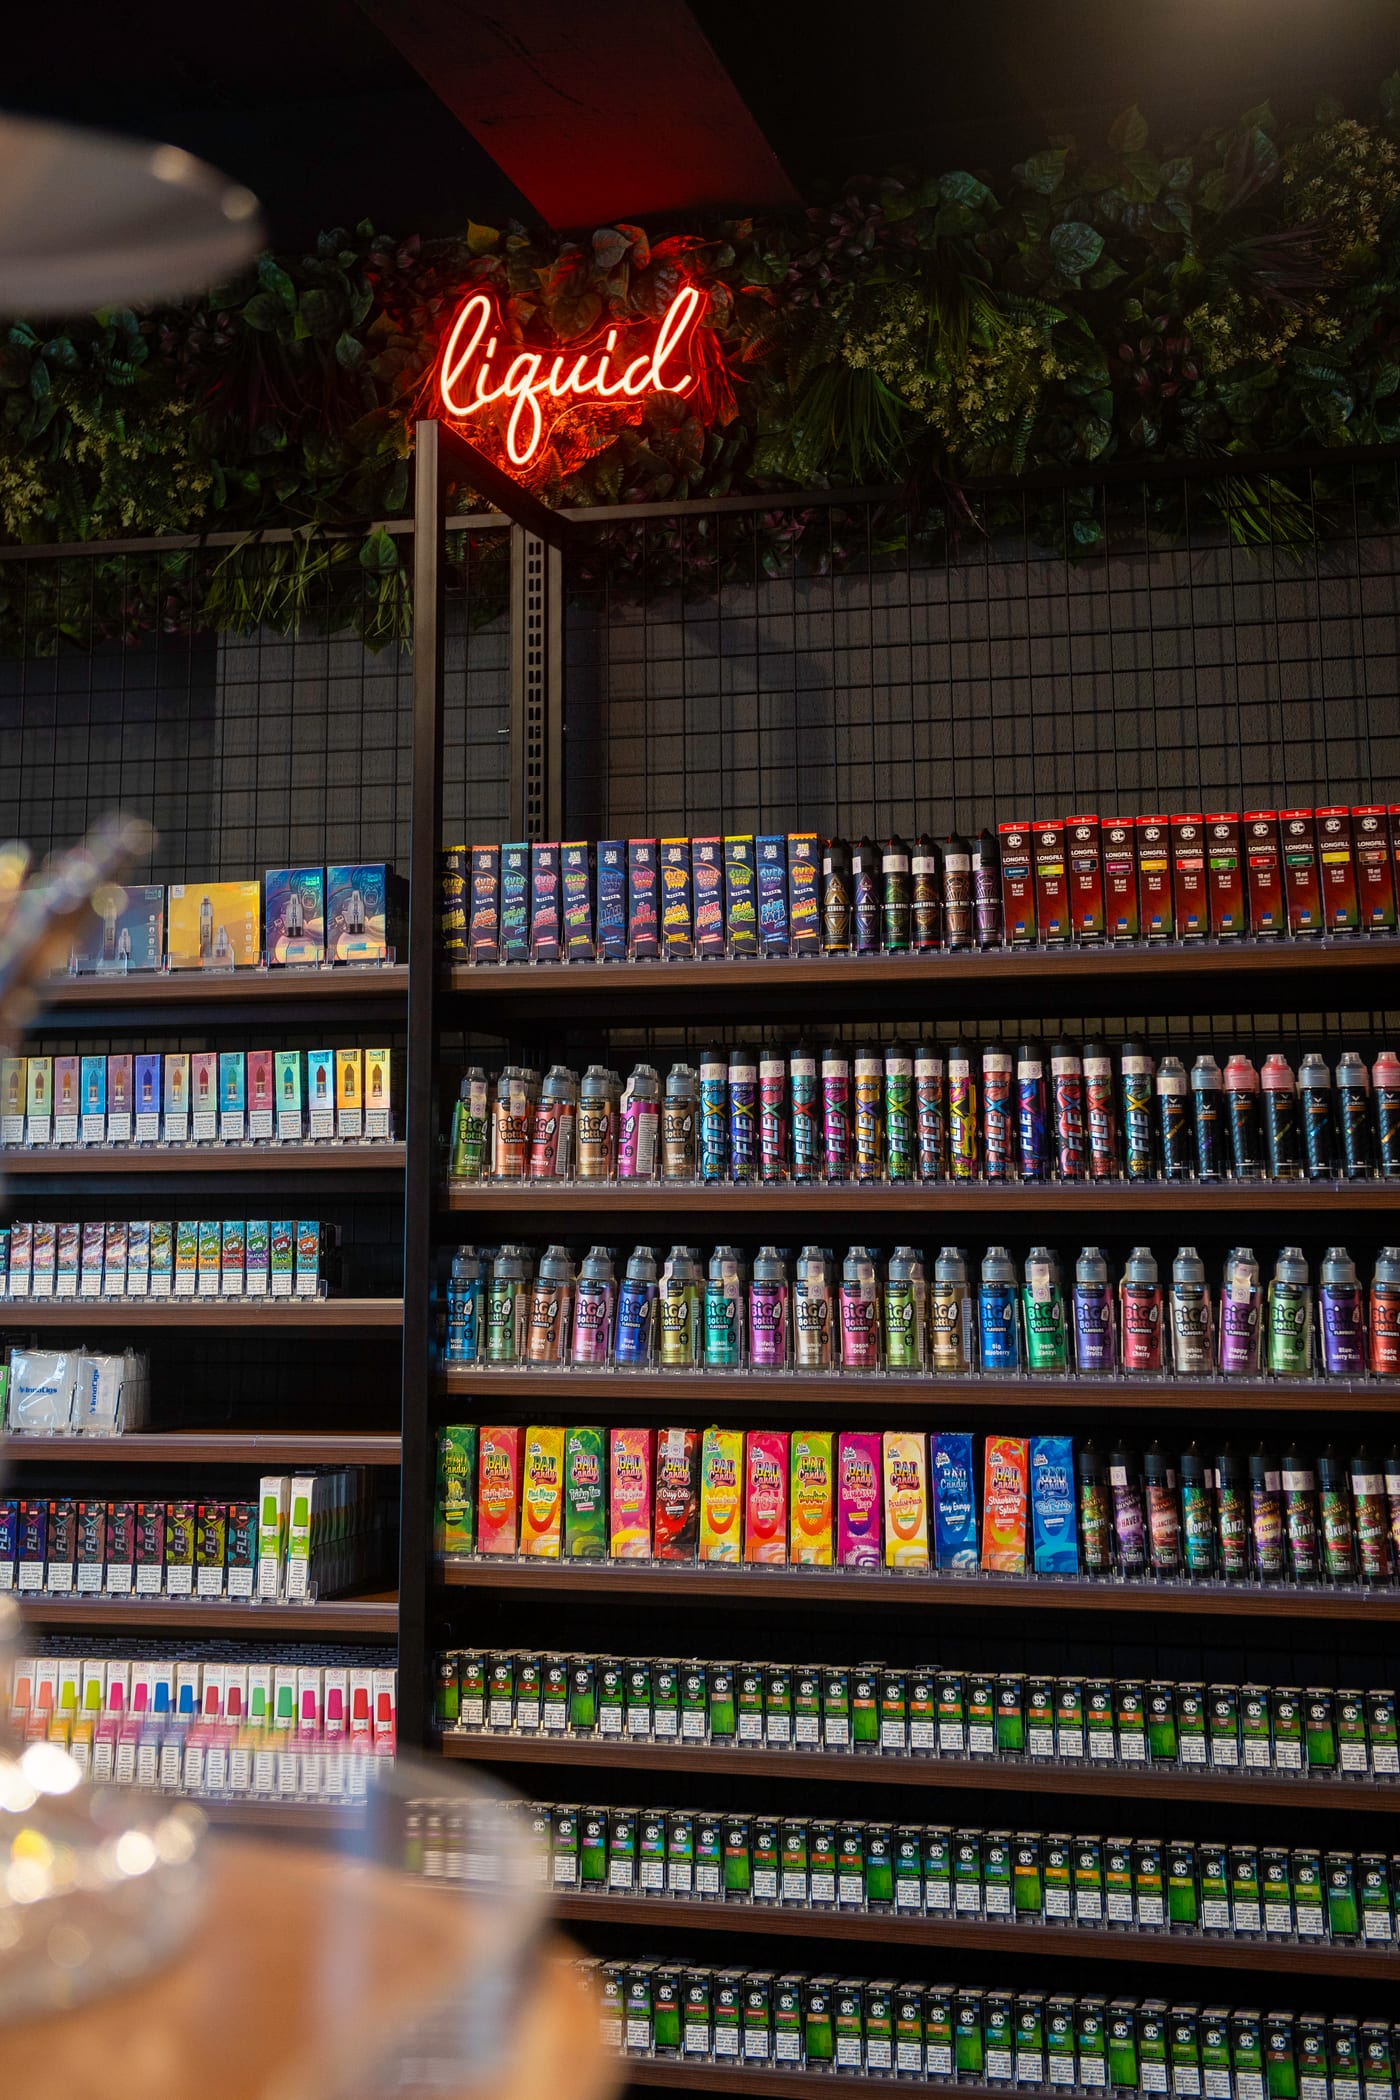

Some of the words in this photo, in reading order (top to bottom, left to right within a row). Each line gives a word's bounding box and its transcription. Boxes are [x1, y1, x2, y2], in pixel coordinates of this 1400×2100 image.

[440, 286, 699, 465] liquid
[703, 1098, 727, 1156] FLEX
[731, 1098, 755, 1156] FLEX
[760, 1099, 782, 1156] FLEX
[791, 1099, 817, 1157] FLEX
[824, 1096, 848, 1153] FLEX
[856, 1096, 878, 1154] FLEX
[887, 1096, 911, 1154] FLEX
[918, 1095, 943, 1154] FLEX
[984, 1096, 1009, 1154] FLEX
[1019, 1094, 1036, 1152] FLEX
[1061, 1093, 1083, 1151] FLEX
[1087, 1094, 1109, 1153] FLEX
[1126, 1093, 1151, 1153] FLEX
[26, 1515, 40, 1552] FLEX
[54, 1515, 68, 1552] FLEX
[83, 1515, 99, 1552] FLEX
[112, 1515, 127, 1552] FLEX
[142, 1516, 157, 1552] FLEX
[173, 1516, 189, 1553] FLEX
[203, 1516, 219, 1554] FLEX
[233, 1517, 250, 1555] FLEX
